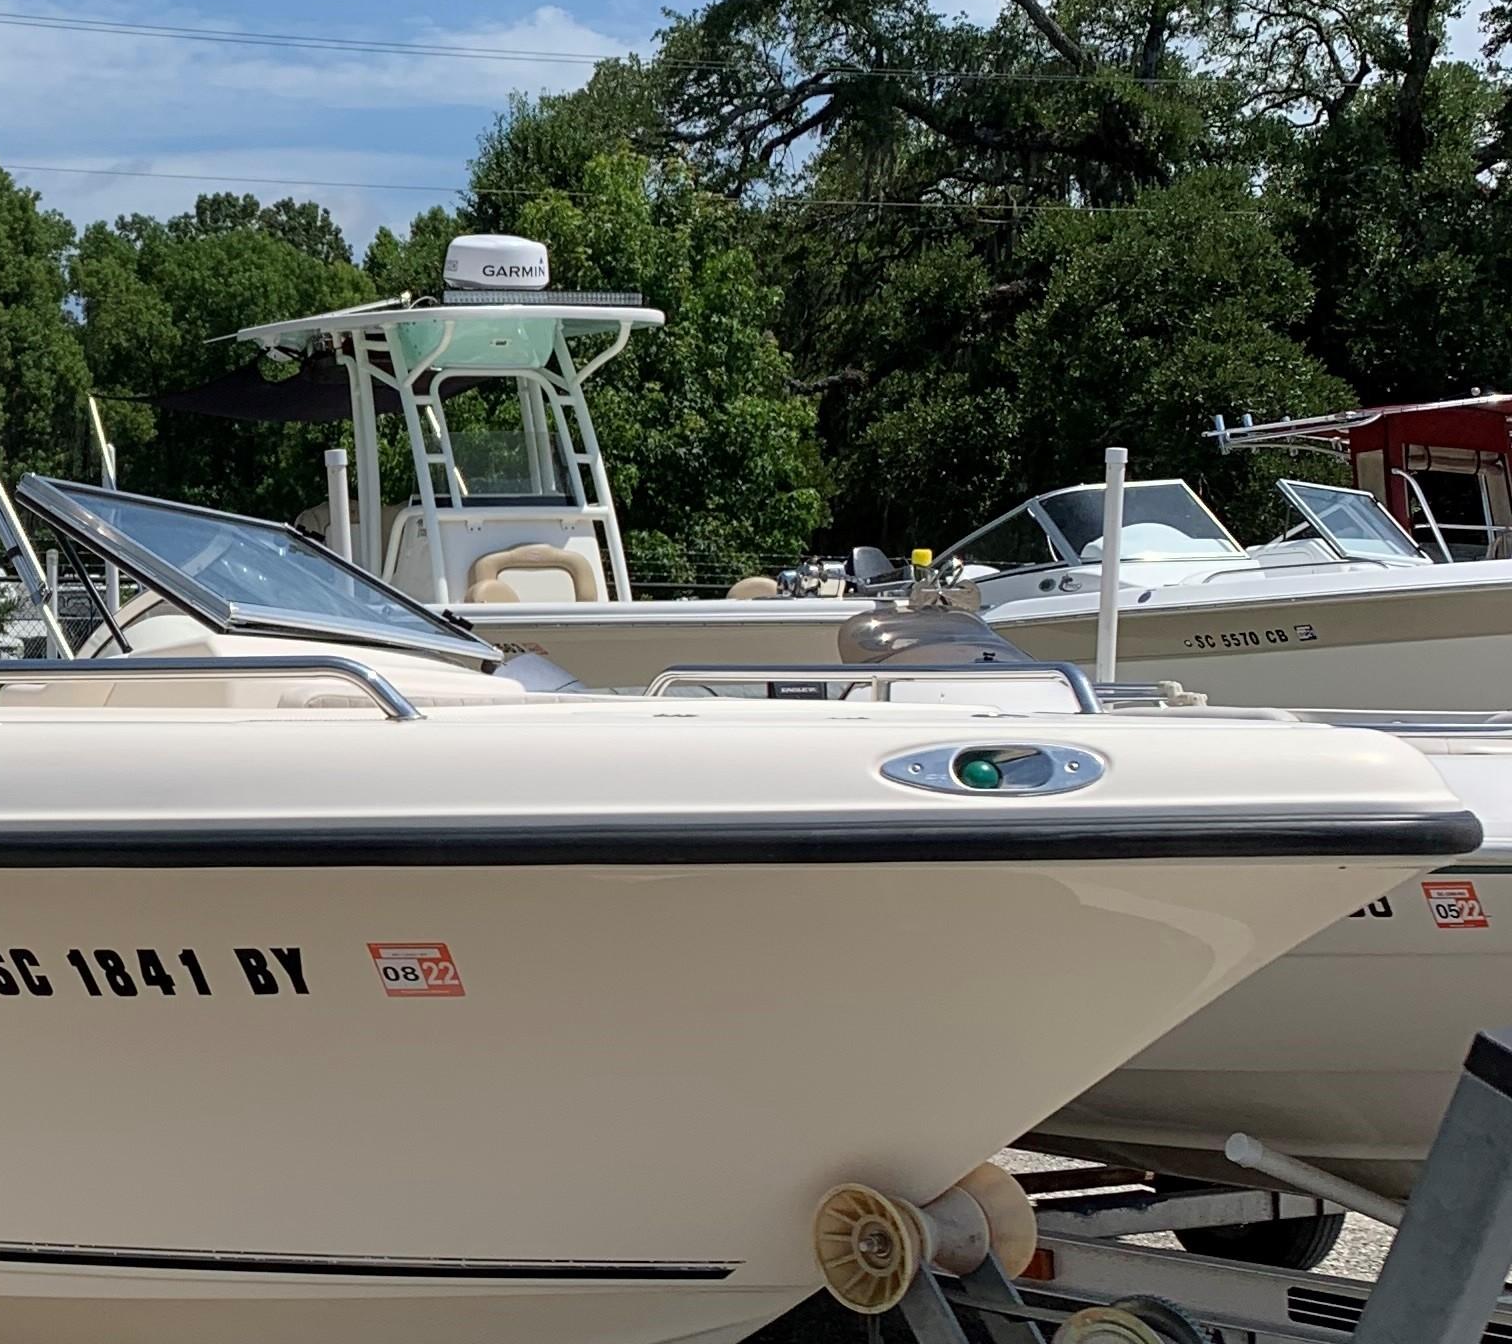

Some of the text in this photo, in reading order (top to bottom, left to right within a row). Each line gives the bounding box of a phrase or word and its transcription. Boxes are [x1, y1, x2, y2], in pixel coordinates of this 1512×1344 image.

[482, 265, 545, 278] GARMIN
[1194, 635, 1216, 649] SC
[1220, 631, 1260, 648] 5570
[1265, 629, 1288, 644] CB
[1435, 903, 1460, 919] 05
[66, 949, 212, 996] 1841
[233, 948, 310, 994] BY
[382, 961, 460, 985] 08 22
